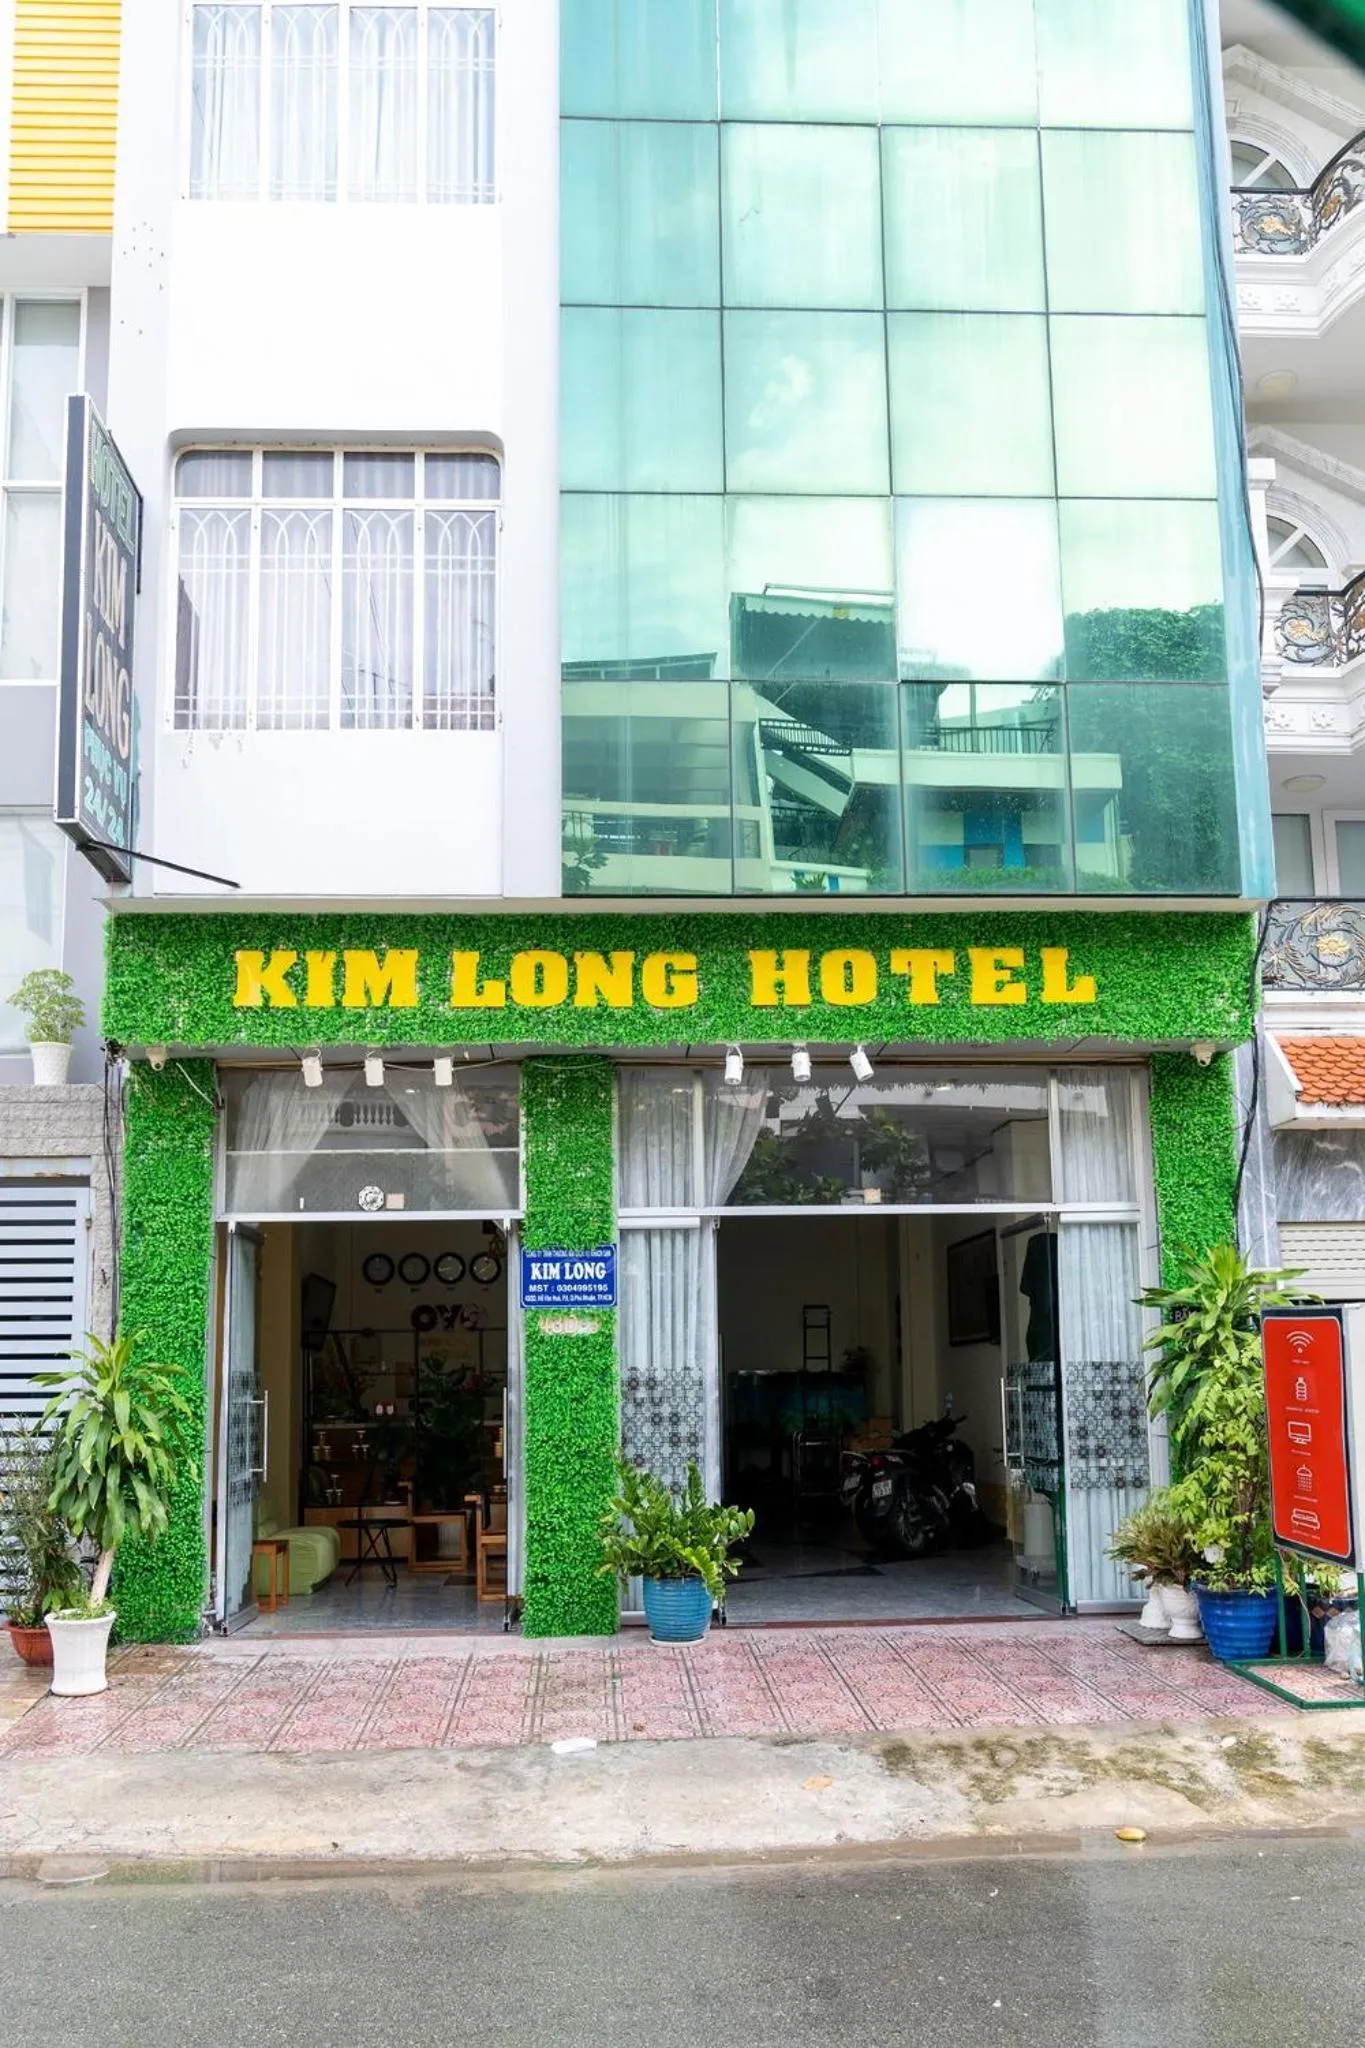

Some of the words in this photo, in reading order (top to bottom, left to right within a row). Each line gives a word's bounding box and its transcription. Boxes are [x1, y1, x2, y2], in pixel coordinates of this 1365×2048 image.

[90, 418, 135, 555] HOTEL
[92, 511, 128, 650] KIM
[84, 611, 130, 760] LONG
[233, 950, 419, 1008] KIM
[450, 950, 698, 1008] LONG
[750, 949, 1095, 1008] HOTEL
[529, 1284, 549, 1292] MST
[531, 1262, 560, 1280] KIM
[564, 1262, 606, 1280] LONG
